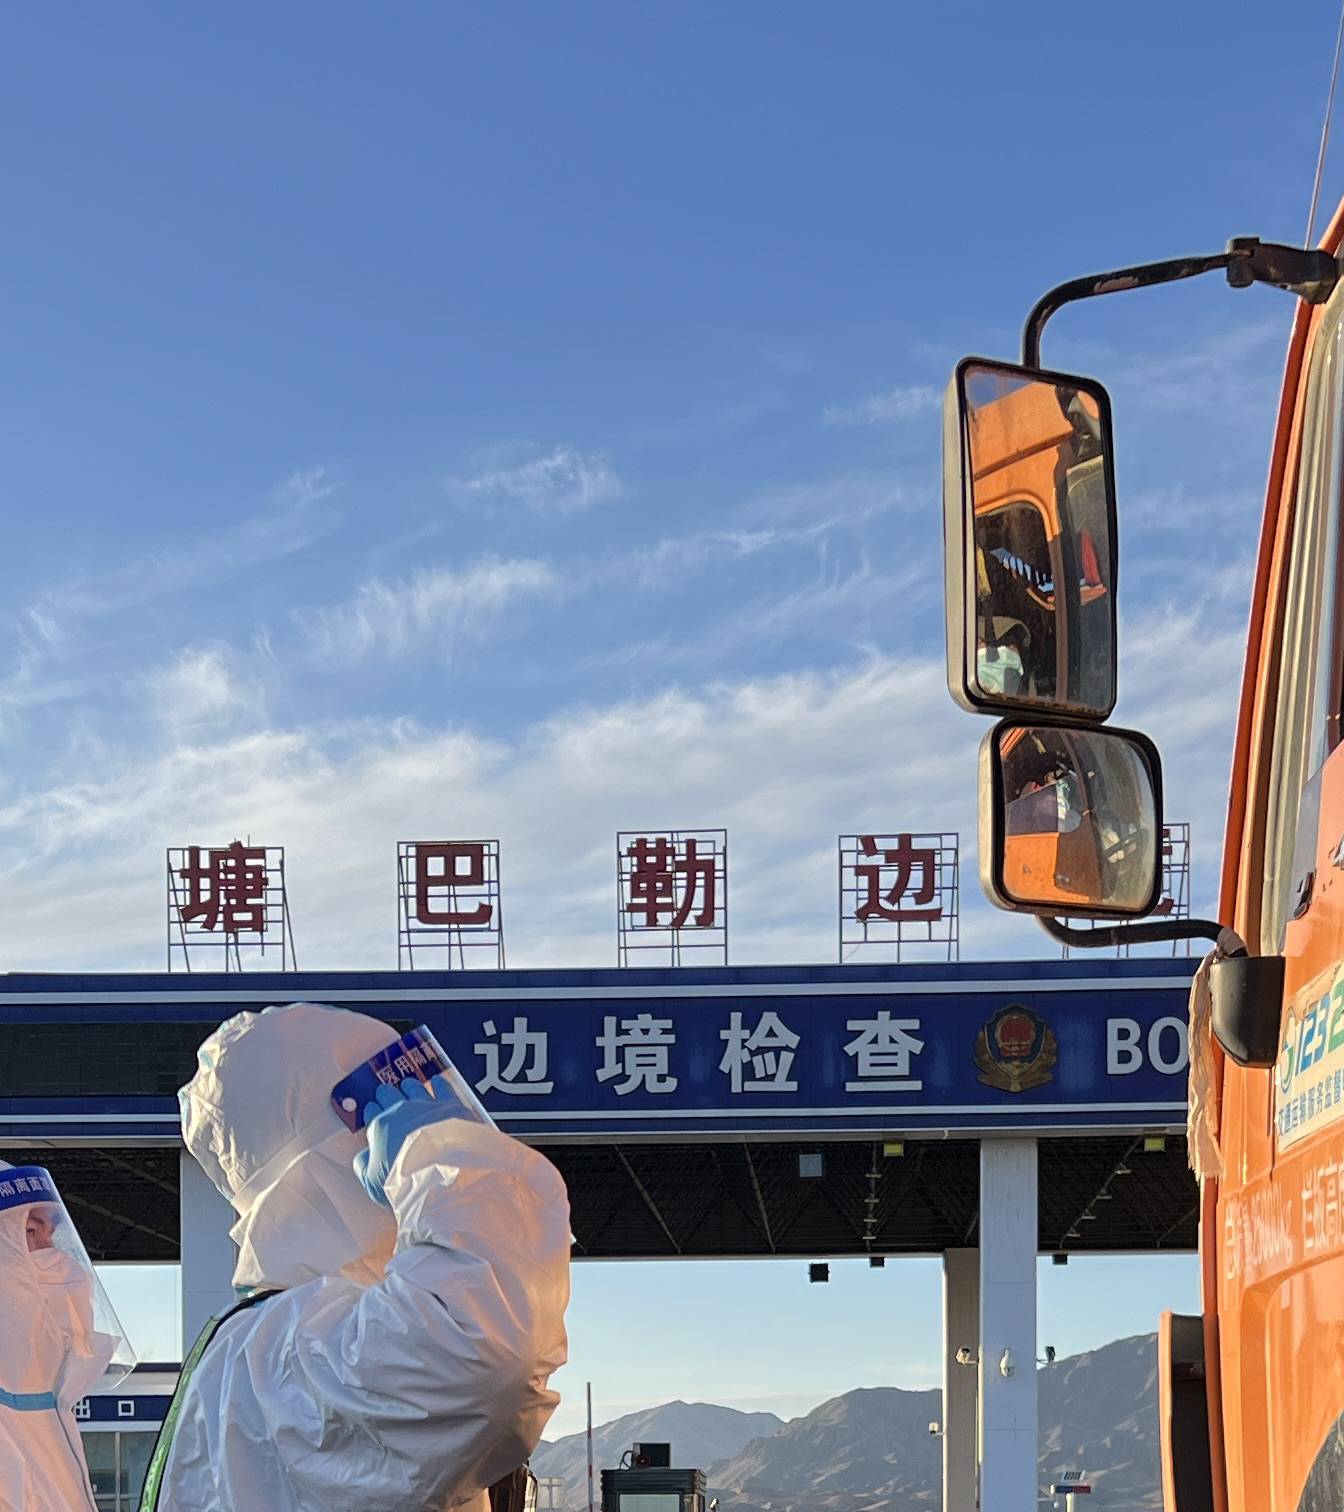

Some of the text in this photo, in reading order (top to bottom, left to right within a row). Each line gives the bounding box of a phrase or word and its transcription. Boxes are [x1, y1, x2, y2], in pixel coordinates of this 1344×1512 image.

[180, 834, 1174, 934] 塘巴勒边
[475, 1011, 924, 1095] 边境检查
[1106, 1016, 1189, 1075] BO
[74, 1399, 135, 1419] 出口
